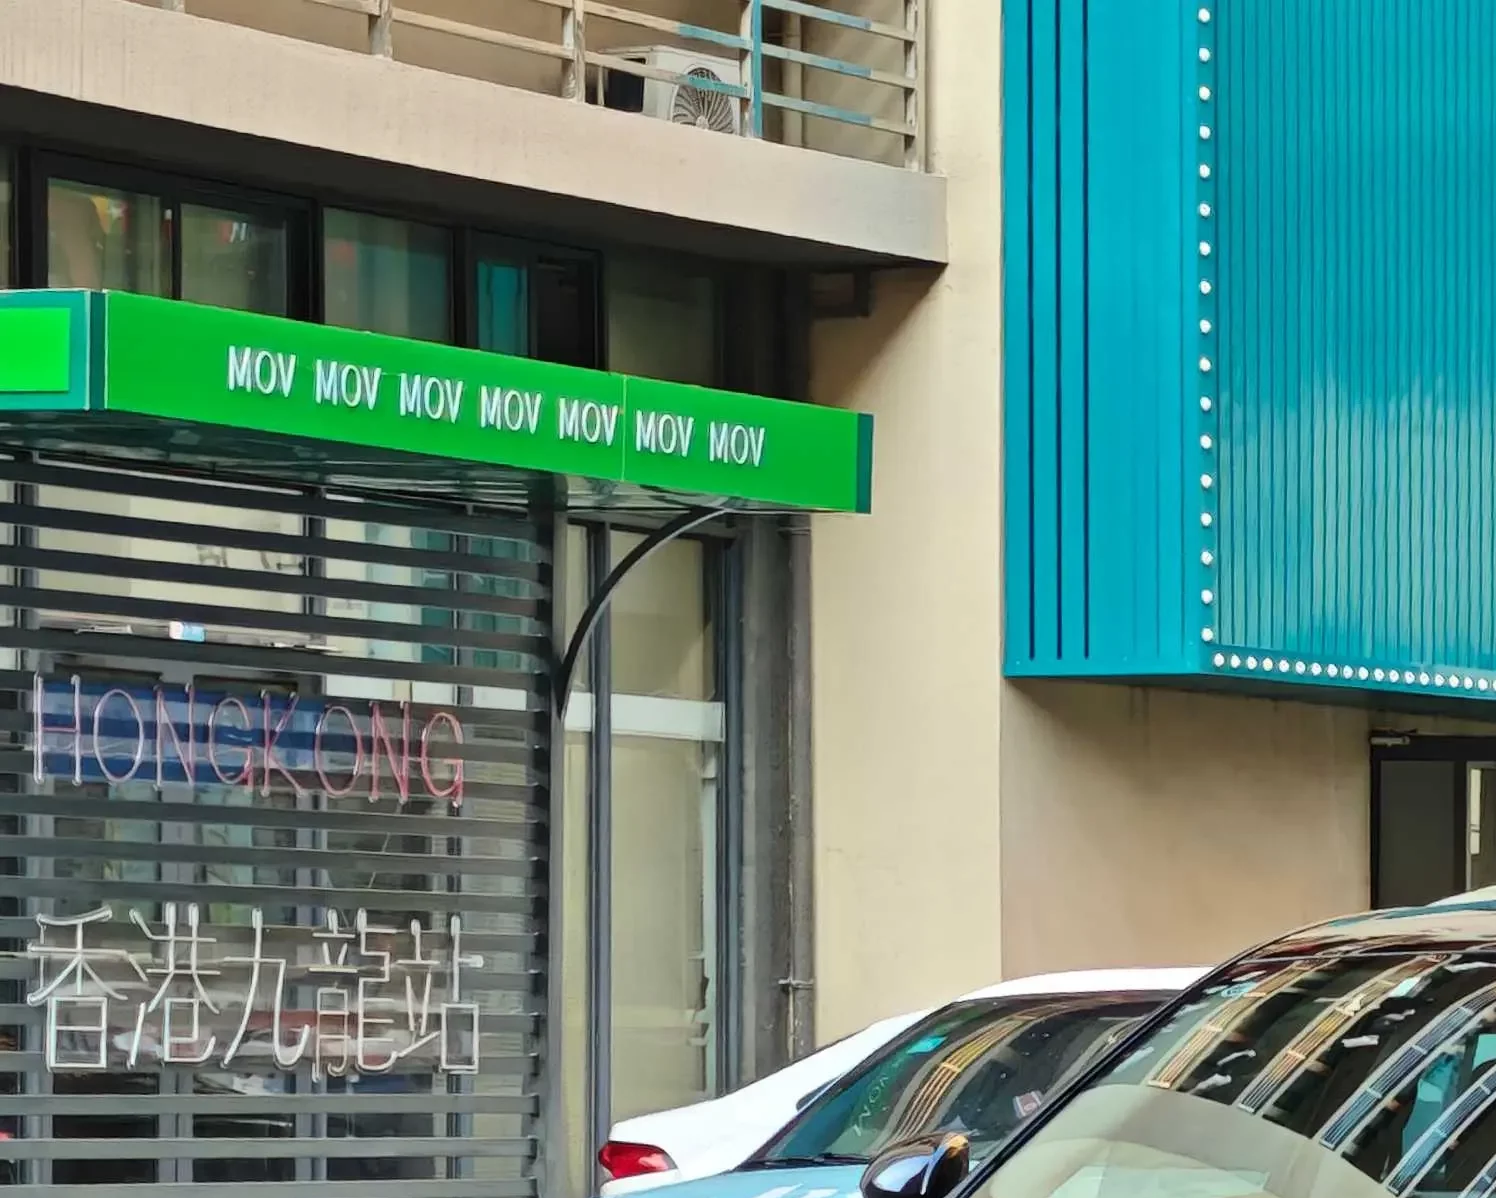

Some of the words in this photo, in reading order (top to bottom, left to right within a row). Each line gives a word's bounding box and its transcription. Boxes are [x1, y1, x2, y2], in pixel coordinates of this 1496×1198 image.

[228, 345, 297, 398] MOV
[315, 359, 382, 411] MOV
[400, 372, 464, 424] MOV
[480, 385, 542, 434] MOV
[559, 397, 619, 446] MOV
[636, 410, 694, 457] MOV
[709, 421, 765, 467] MOV
[27, 901, 485, 1082] 香港九龍站
